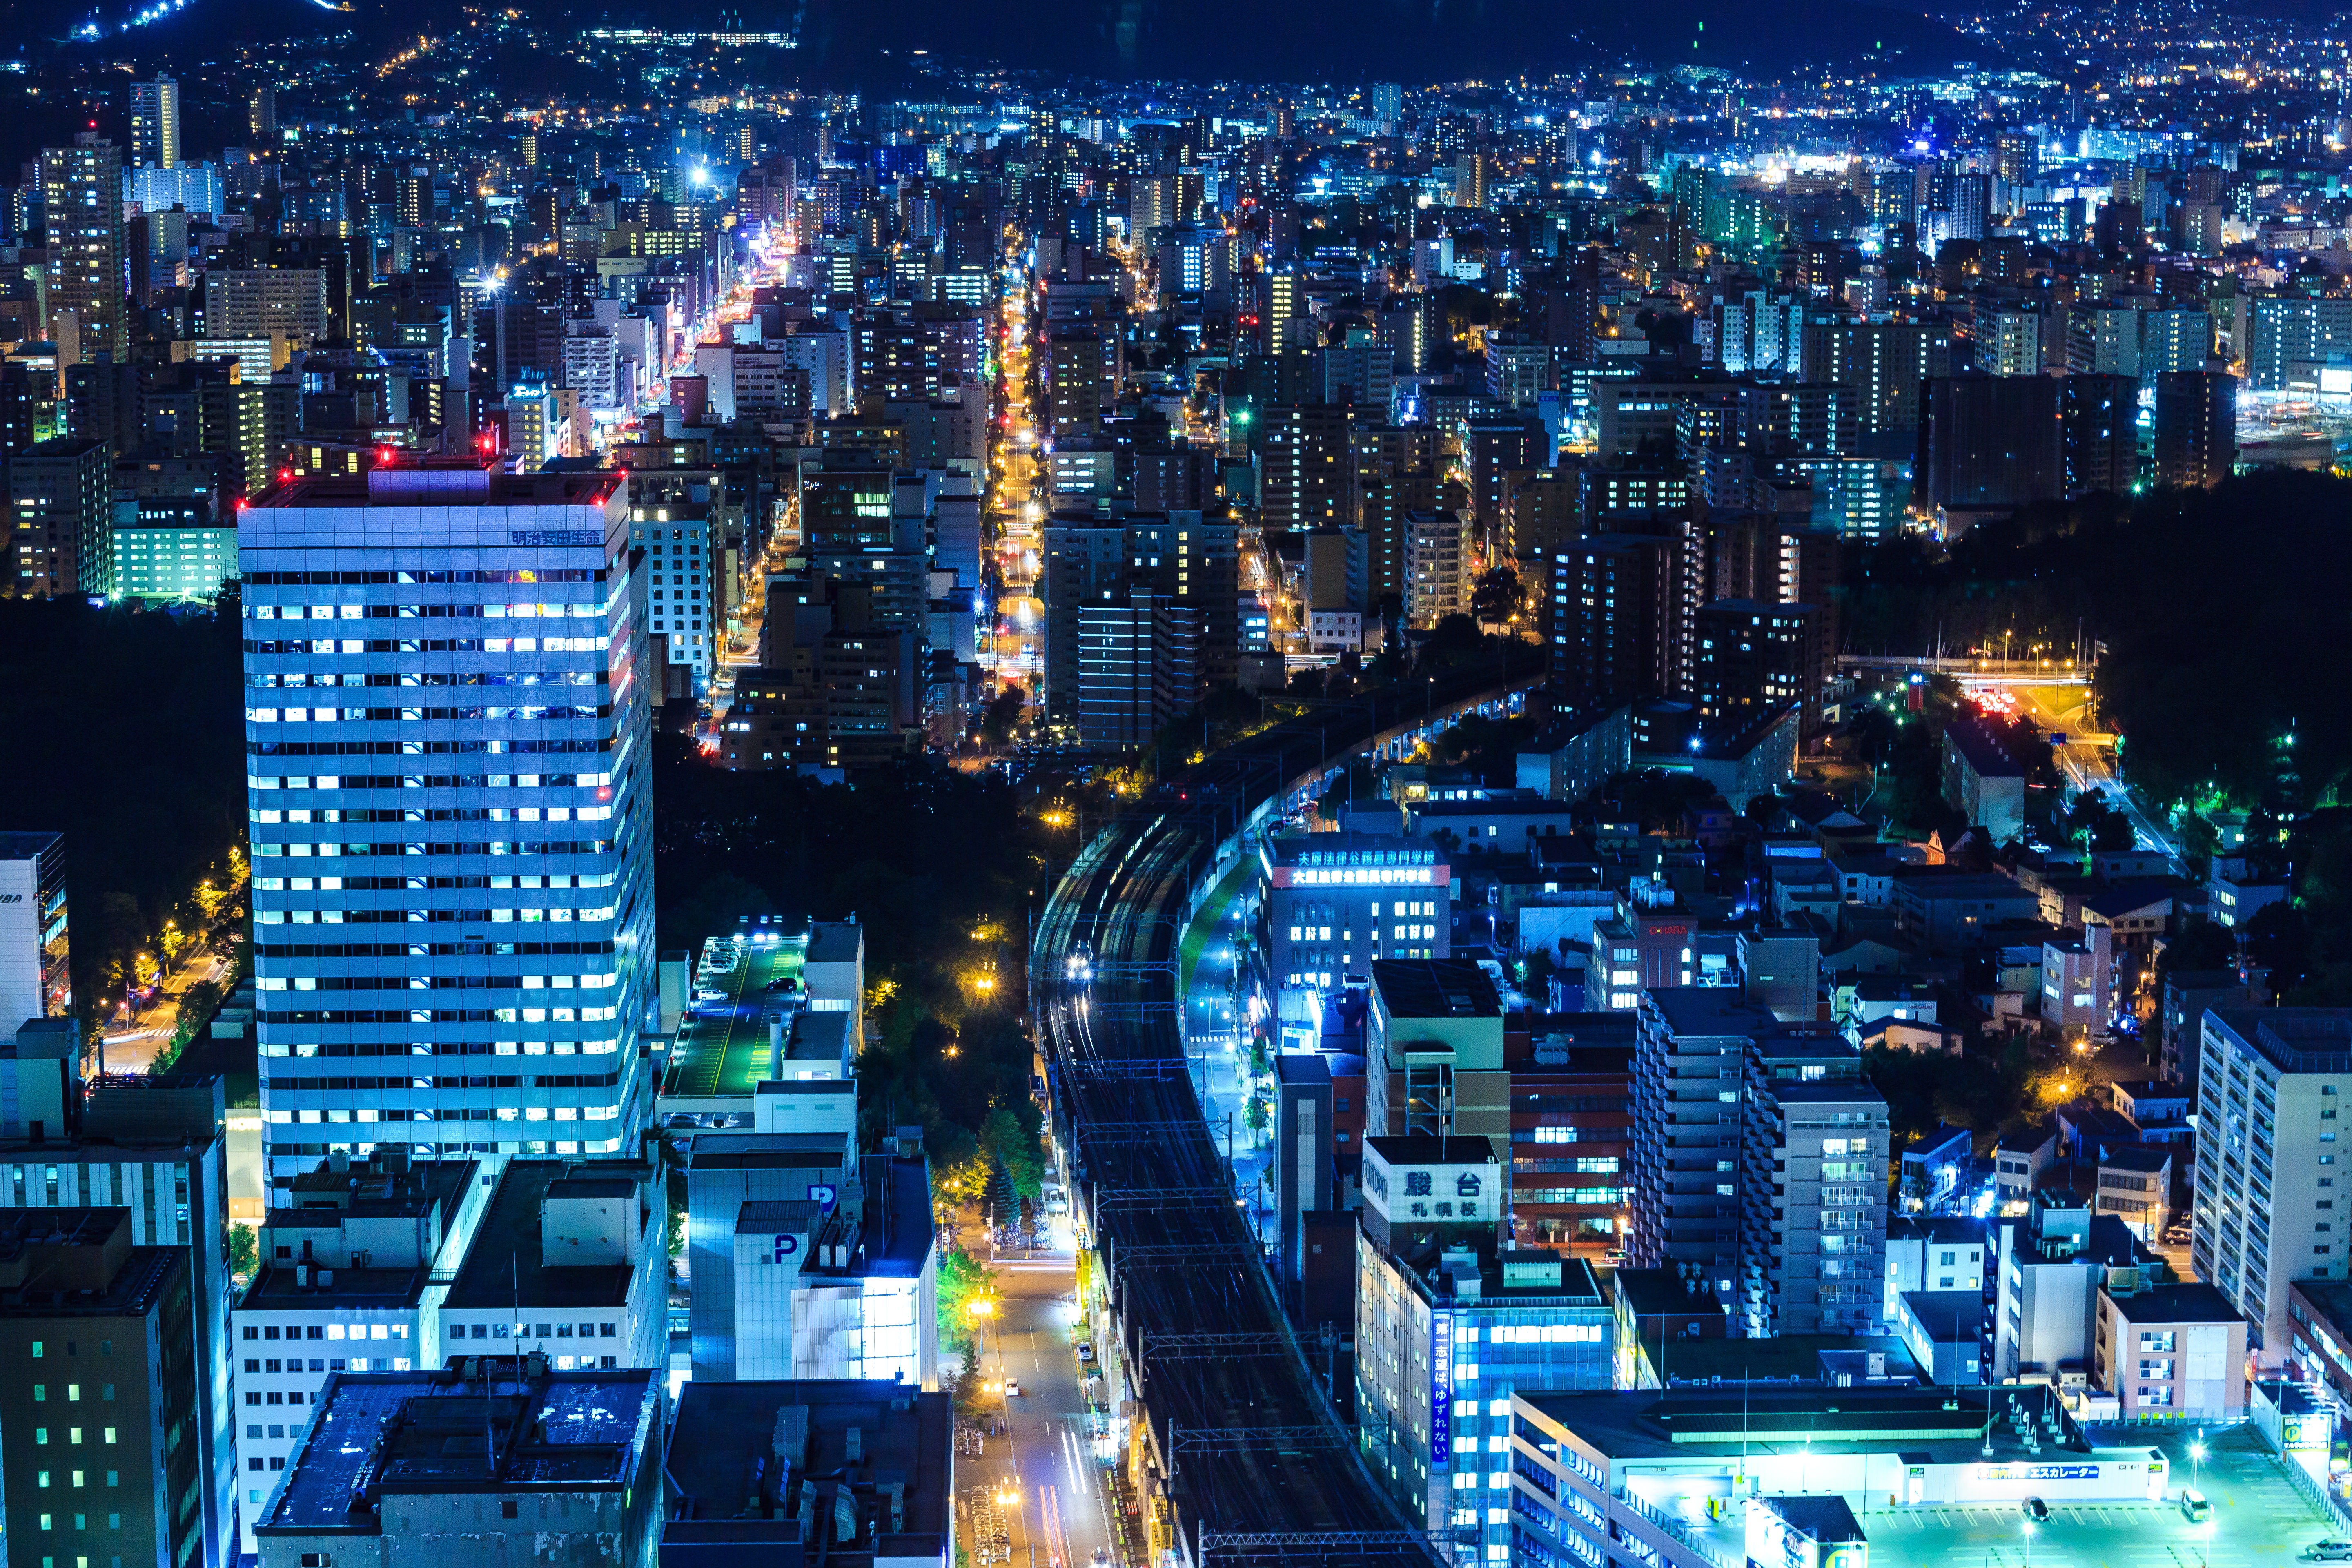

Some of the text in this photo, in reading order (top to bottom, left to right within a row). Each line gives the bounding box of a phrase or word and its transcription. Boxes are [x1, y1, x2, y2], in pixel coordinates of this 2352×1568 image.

[512, 531, 600, 545] 明治安田生命
[1412, 1202, 1477, 1217] 札幌校
[775, 1235, 798, 1264] P
[1434, 1323, 1448, 1460] 第一志望は、ゆずれない。
[2290, 1429, 2297, 1438] P
[2030, 1468, 2098, 1478] エスカレーター
